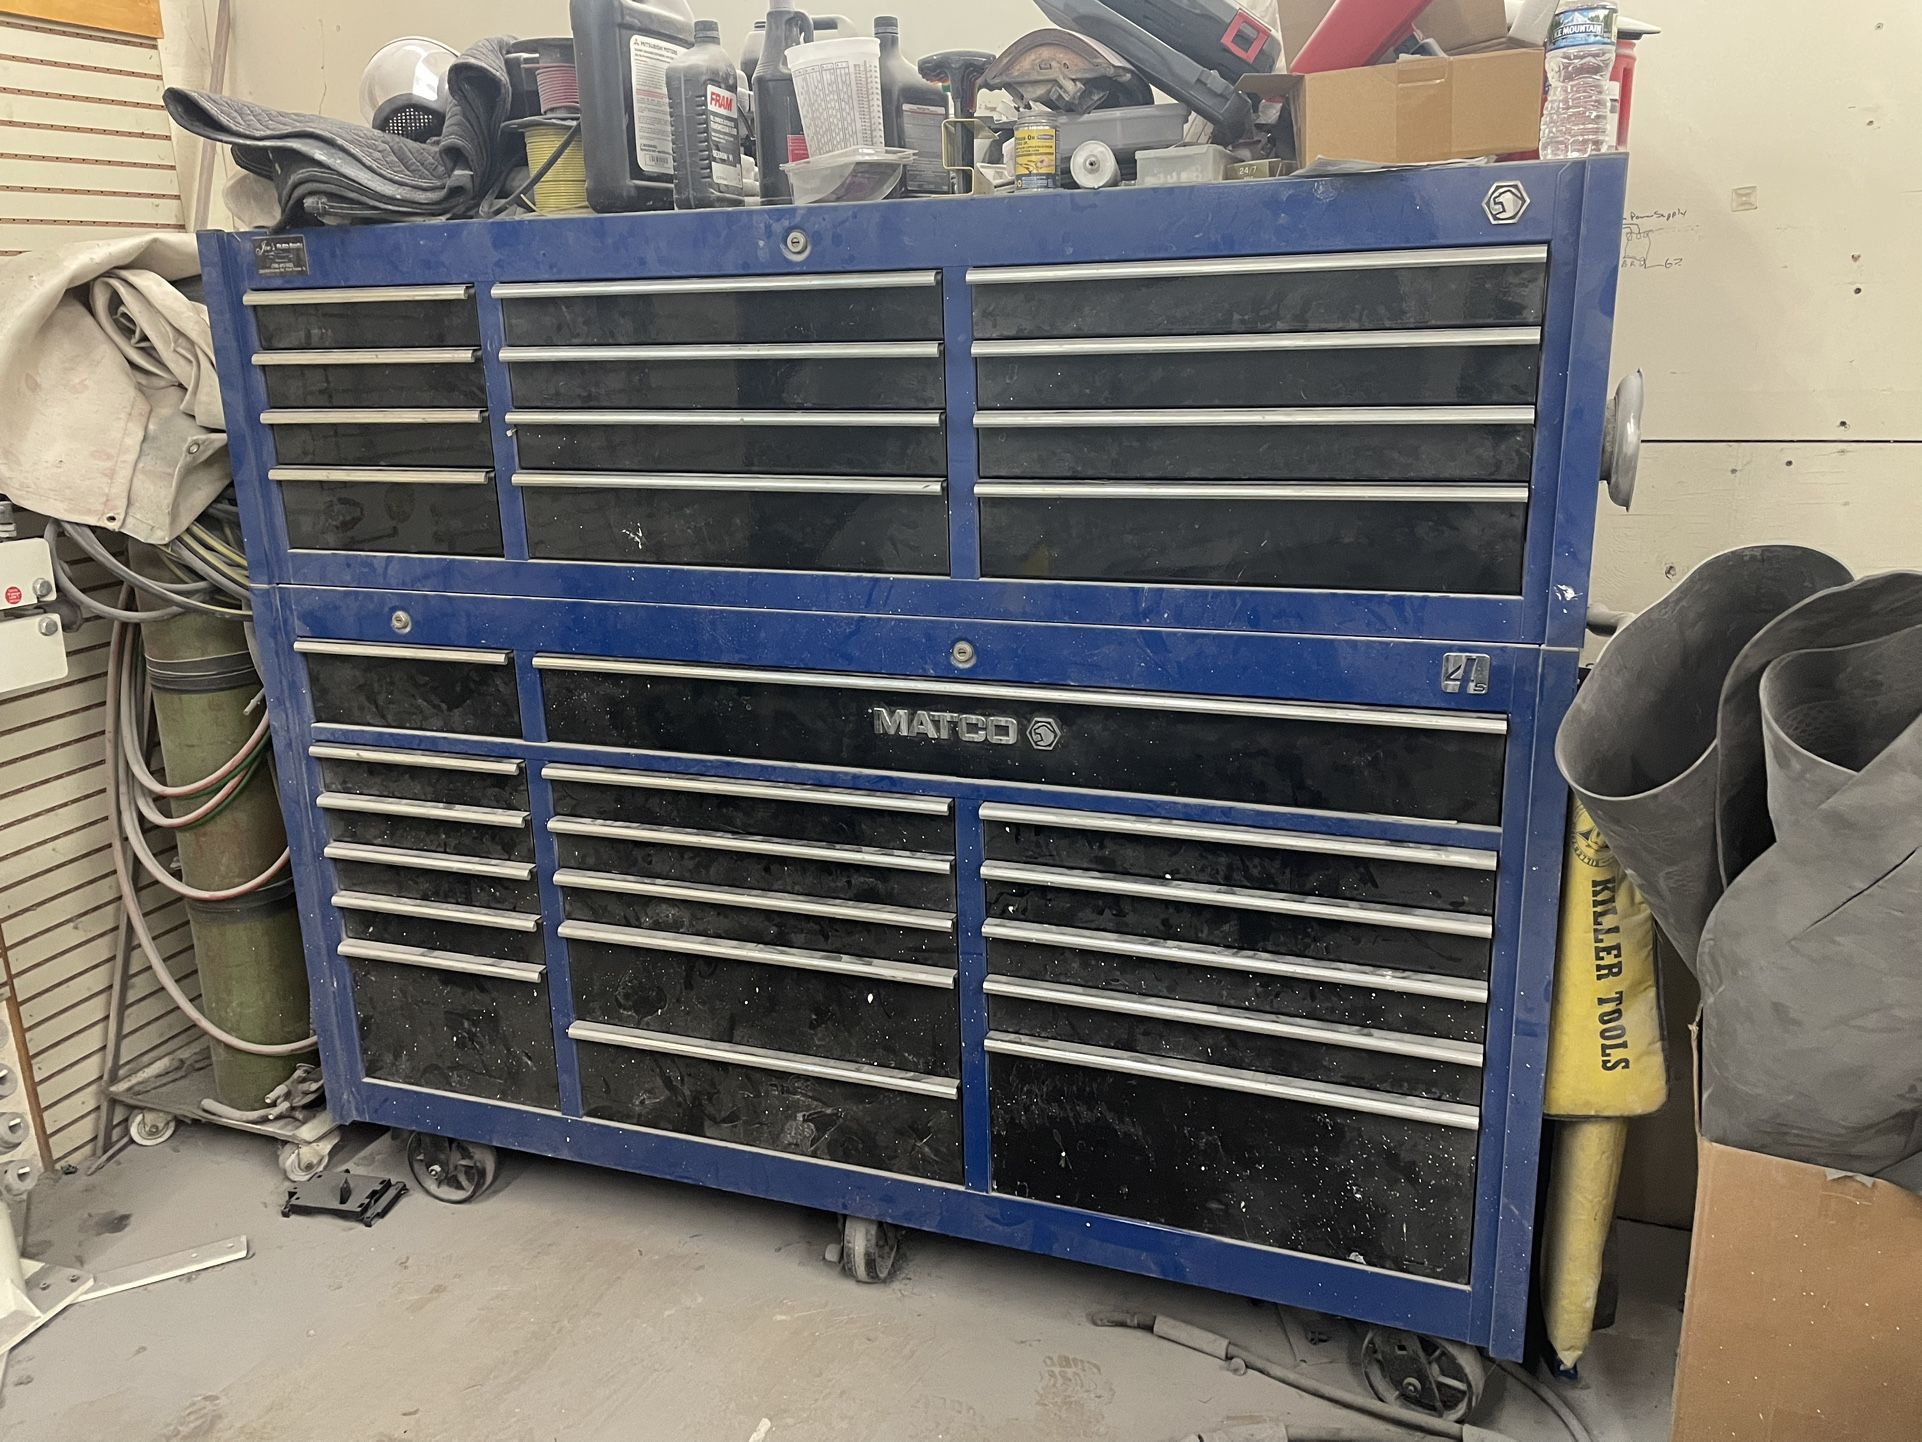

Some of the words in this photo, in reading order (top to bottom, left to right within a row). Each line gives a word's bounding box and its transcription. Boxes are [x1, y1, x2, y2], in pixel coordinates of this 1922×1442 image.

[1562, 23, 1603, 36] MOUNTAIN
[710, 91, 733, 112] FRAM
[873, 707, 1018, 745] MATCO
[1591, 879, 1623, 981] KILLER
[1597, 990, 1630, 1072] TOOLS
